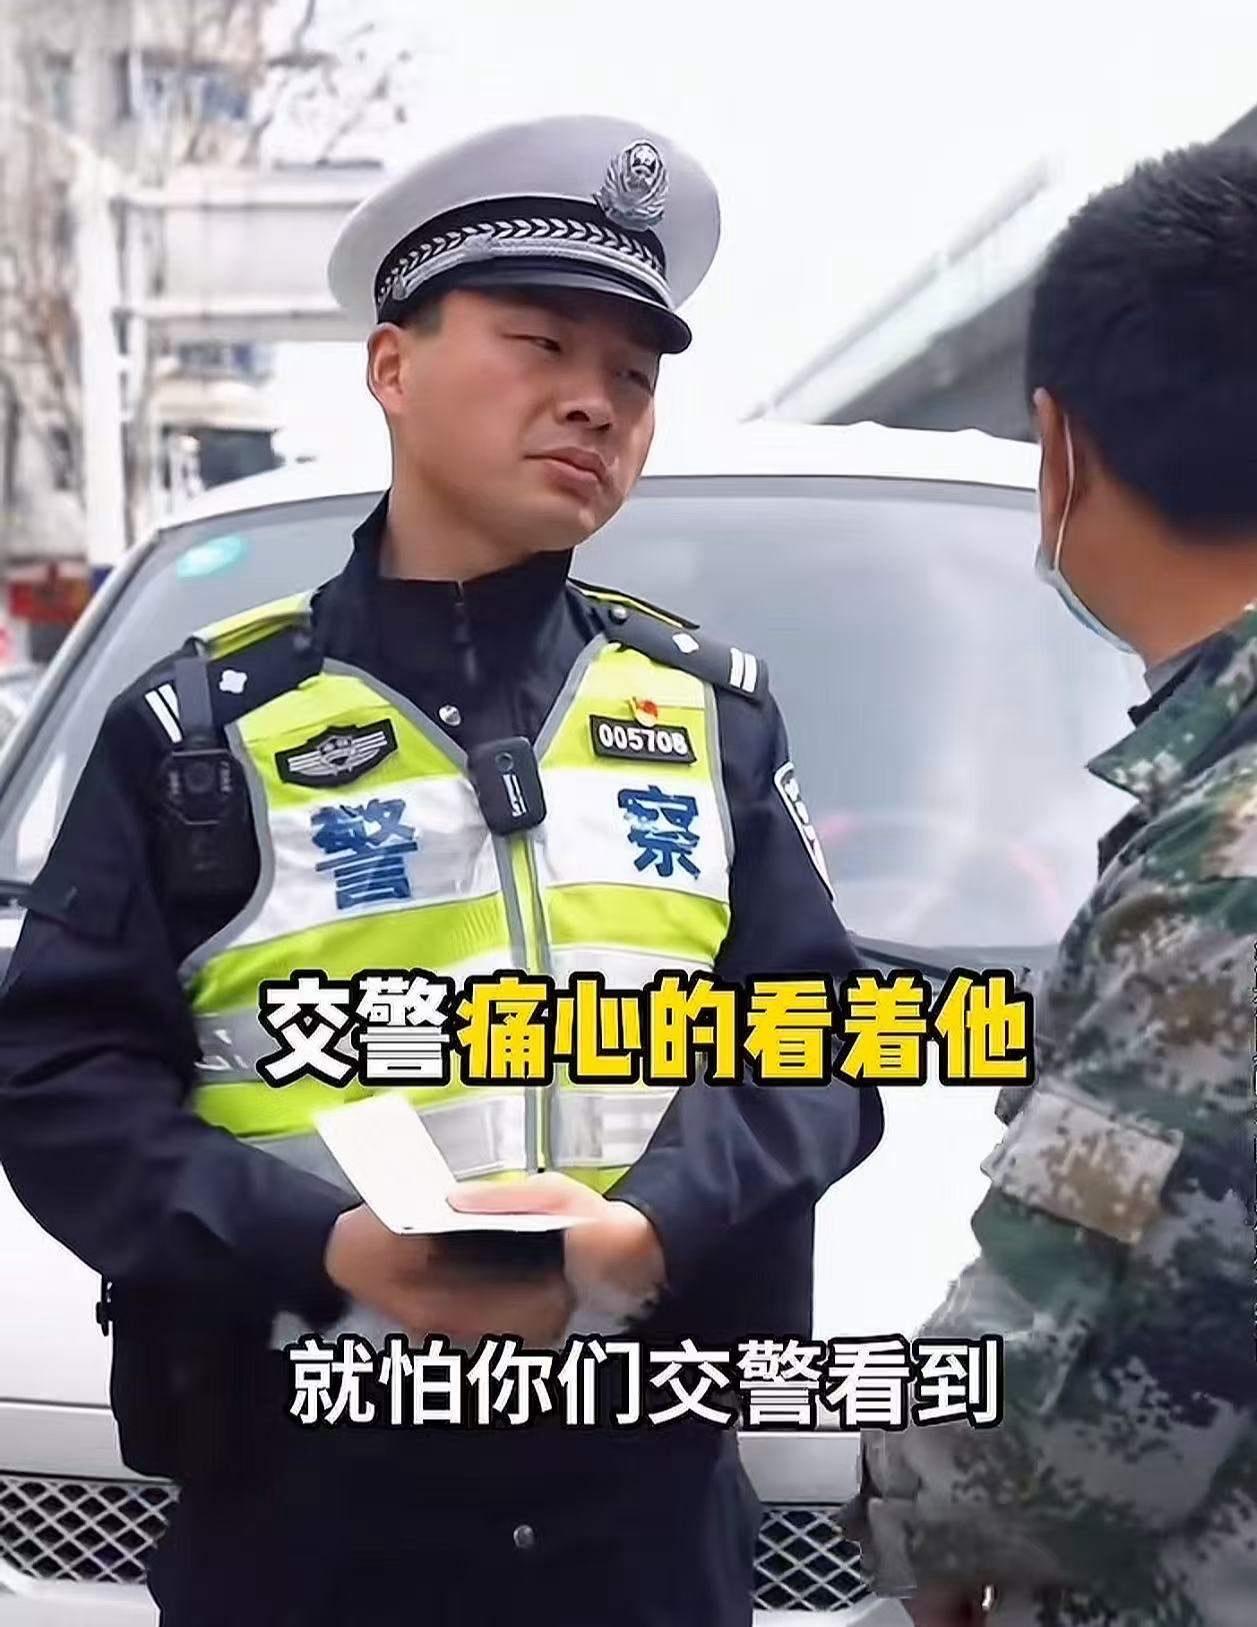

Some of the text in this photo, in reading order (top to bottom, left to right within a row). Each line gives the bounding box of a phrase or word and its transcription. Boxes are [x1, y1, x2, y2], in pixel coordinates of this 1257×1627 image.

[599, 724, 688, 755] 005708
[311, 798, 418, 909] 警
[618, 786, 701, 878] 察
